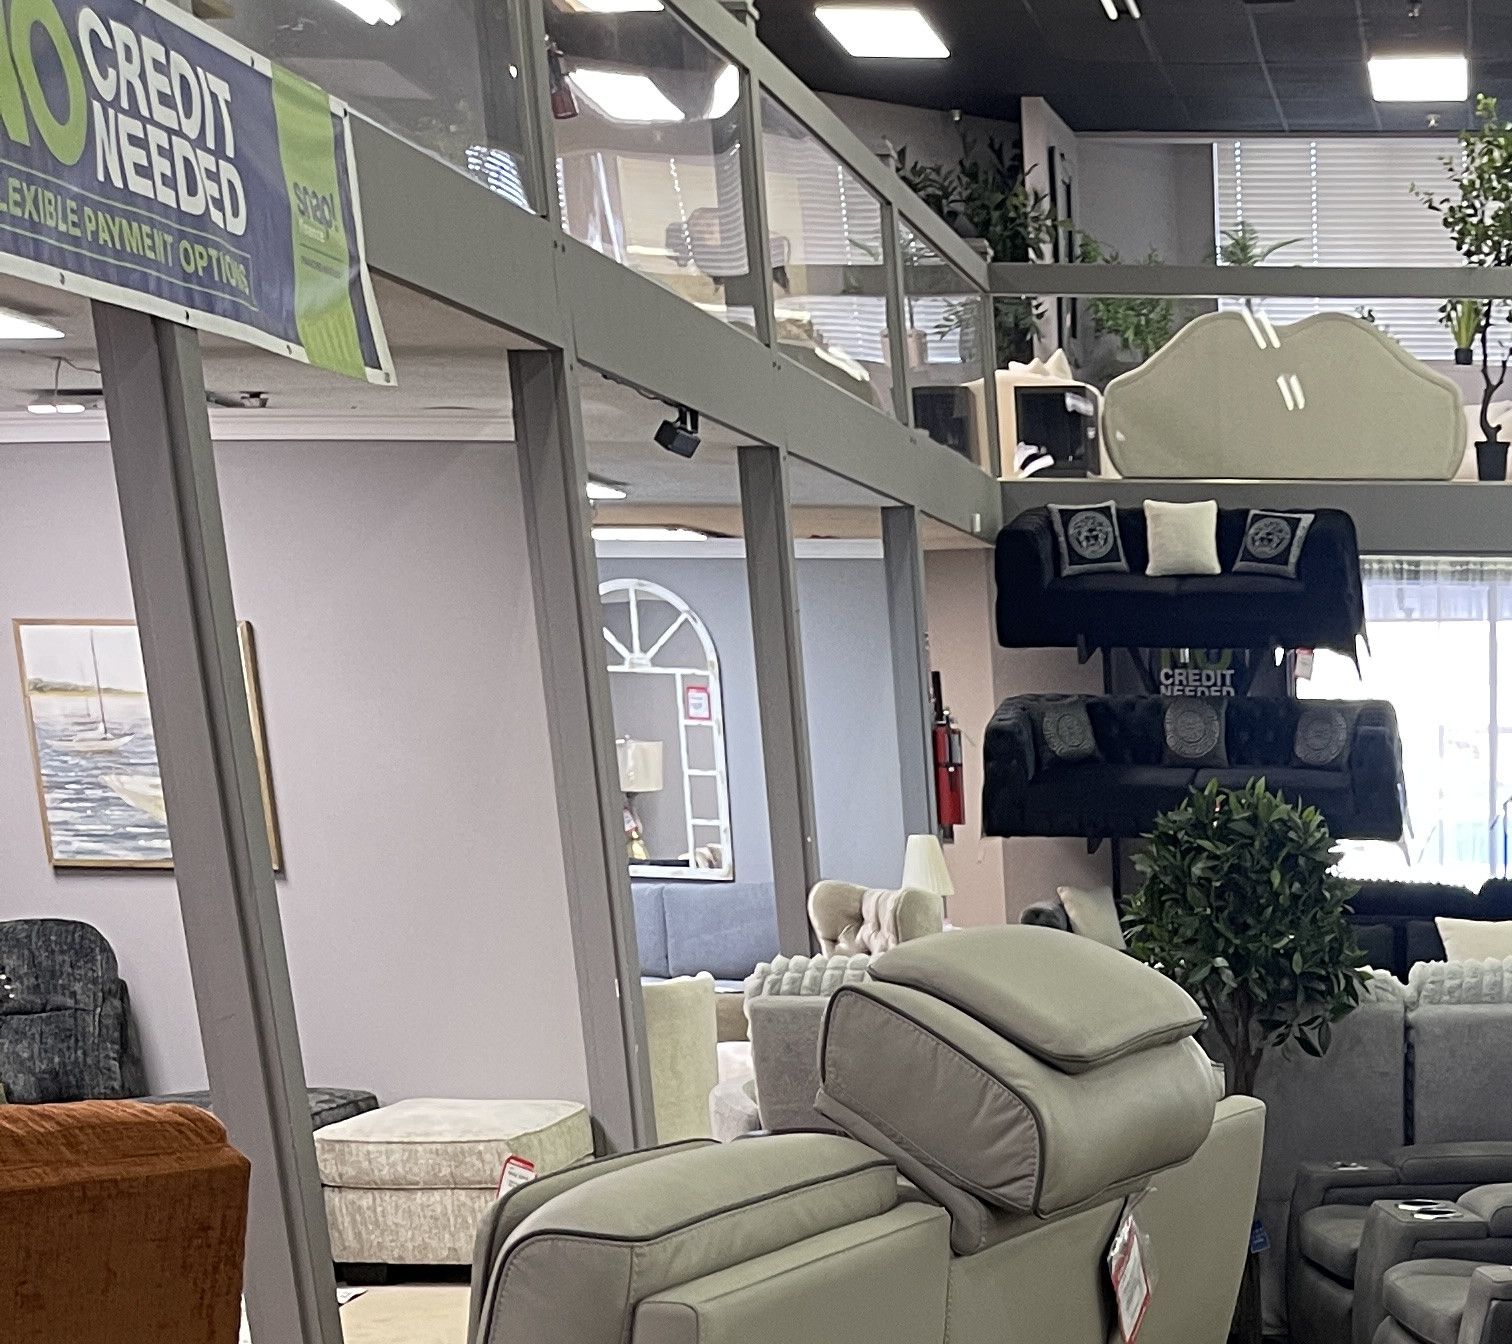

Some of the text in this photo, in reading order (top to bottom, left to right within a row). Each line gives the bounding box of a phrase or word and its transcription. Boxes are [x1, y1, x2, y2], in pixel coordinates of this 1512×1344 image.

[78, 7, 235, 158] CREDIT
[91, 99, 247, 236] NEEDED
[0, 177, 249, 296] EXIBLE PAYMENT OPTIONS
[1160, 668, 1235, 686] CREDIT
